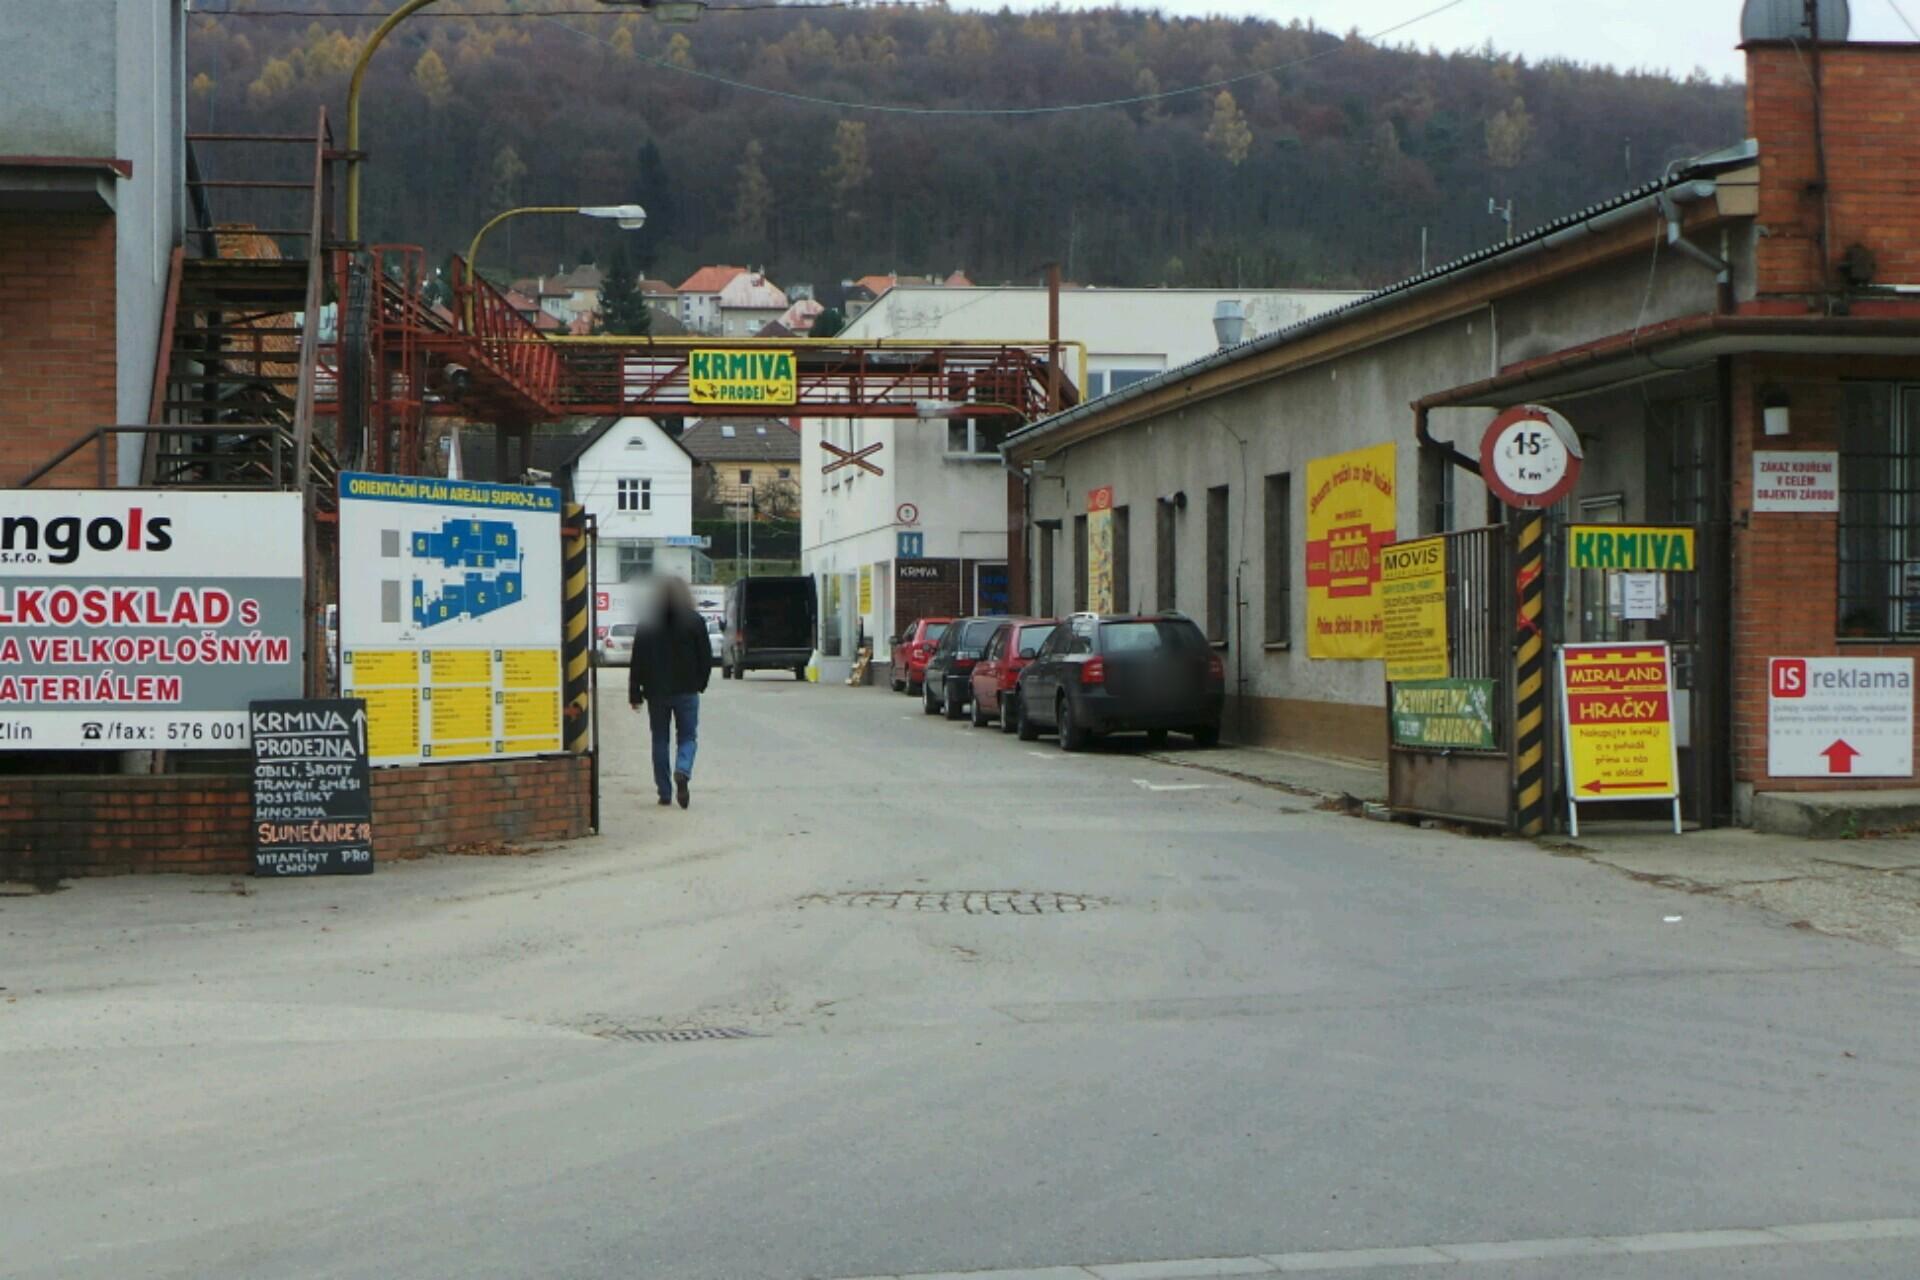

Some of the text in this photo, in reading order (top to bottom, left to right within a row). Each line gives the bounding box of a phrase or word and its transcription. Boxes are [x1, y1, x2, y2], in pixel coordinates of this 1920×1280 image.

[693, 353, 792, 380] KRMIVA
[720, 385, 765, 400] PRODEJ
[1513, 432, 1541, 455] 15
[1760, 461, 1791, 473] ZÁKAZ
[350, 478, 417, 498] ORIENTAČNÍ
[420, 484, 447, 500] PLÁN
[449, 486, 488, 502] AREÁLU
[1757, 488, 1835, 500] OBJEKTU ZÁVODU
[1, 507, 173, 564] ngols
[1, 551, 42, 563] s.r.o.
[1384, 547, 1438, 571] MOVIS
[1575, 532, 1688, 570] KRMIVA
[900, 566, 938, 577] KRMIVA
[1, 632, 289, 663] A VELKOPLOŠNÝM
[0, 671, 181, 702] ATERIÁLEM
[1570, 667, 1663, 683] MIRALAND
[1779, 667, 1909, 690] IS reklama
[1579, 695, 1658, 720] HRAČKY
[167, 723, 202, 740] 576
[211, 723, 245, 740] 001
[252, 711, 349, 731] KRMIVA
[255, 738, 356, 757] PRODEJNA
[258, 821, 355, 844] SLUNEČNICE
[341, 849, 370, 862] PRO
